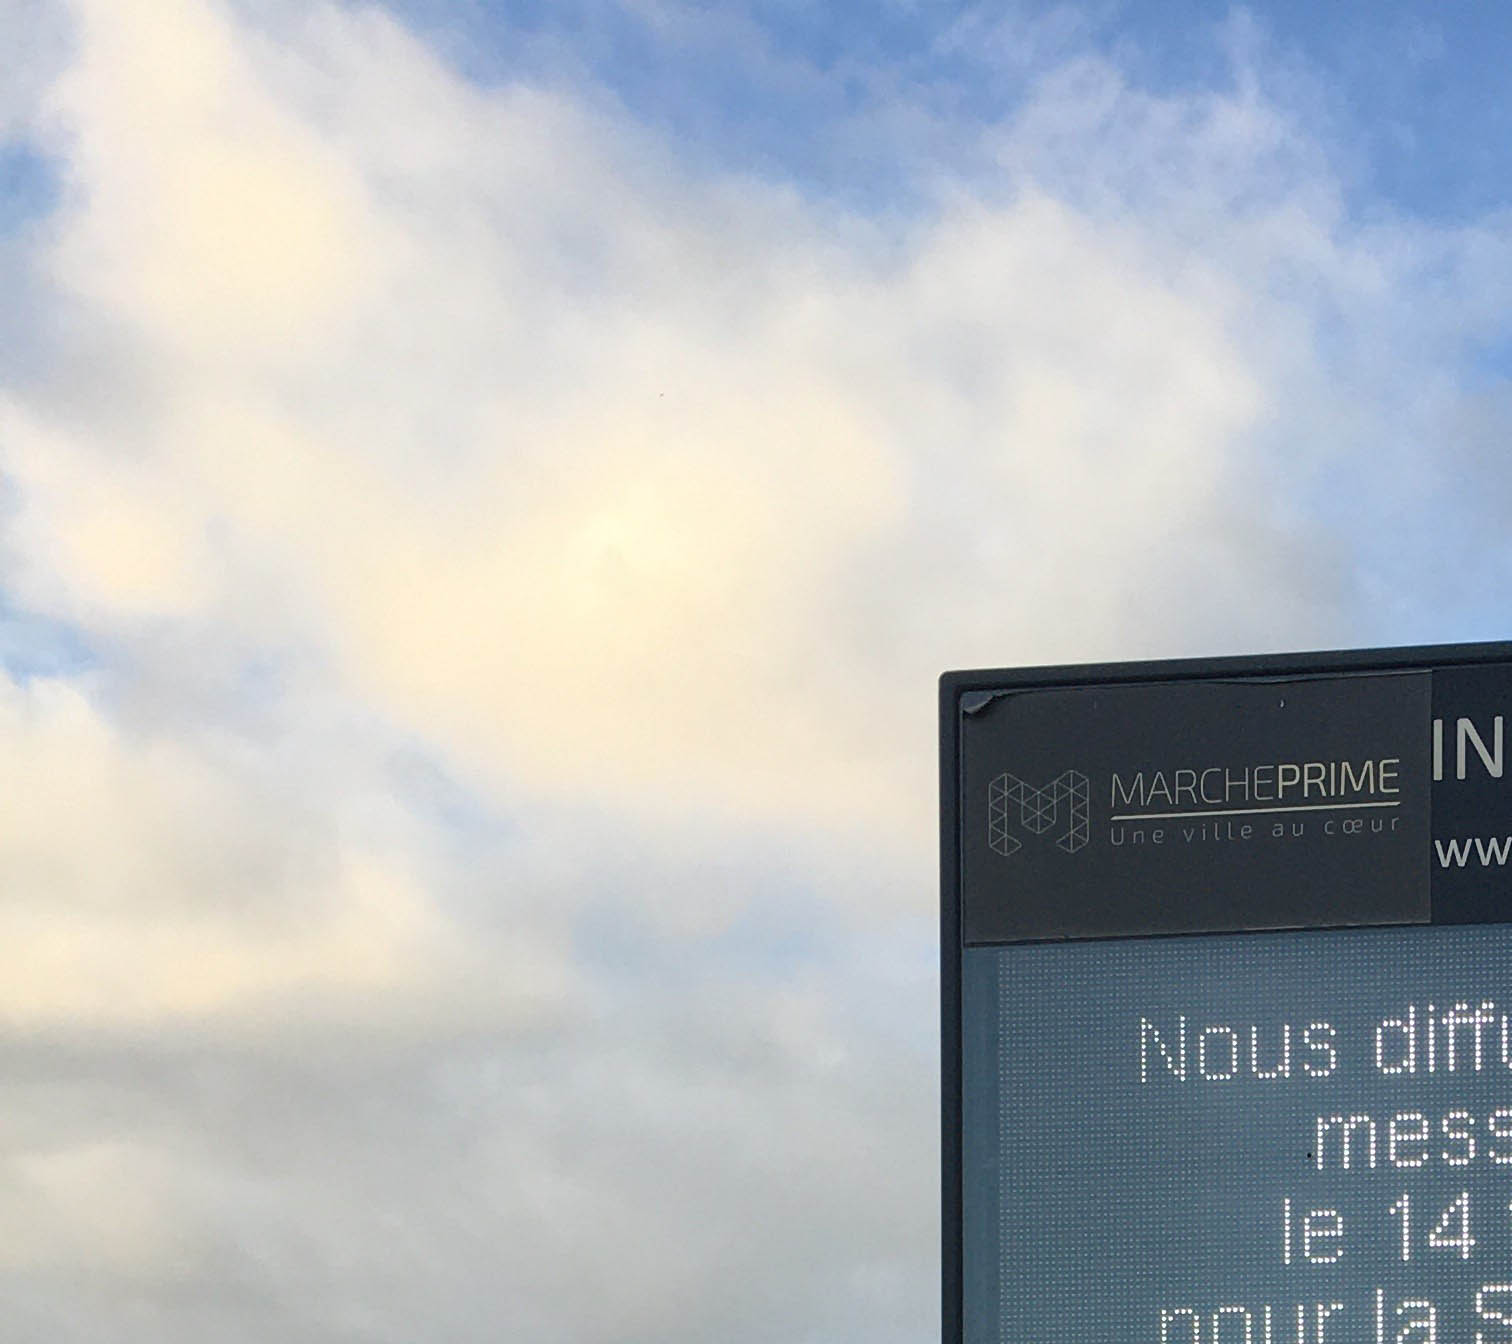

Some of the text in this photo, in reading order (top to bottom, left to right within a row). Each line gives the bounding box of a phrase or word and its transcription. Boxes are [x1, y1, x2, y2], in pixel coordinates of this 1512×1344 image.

[1111, 759, 1400, 808] MARCHEPRIME
[1110, 816, 1400, 846] Une ville au cœur
[1141, 1015, 1337, 1083] Nous
[1284, 1198, 1344, 1265] le
[1389, 1191, 1476, 1262] 14
